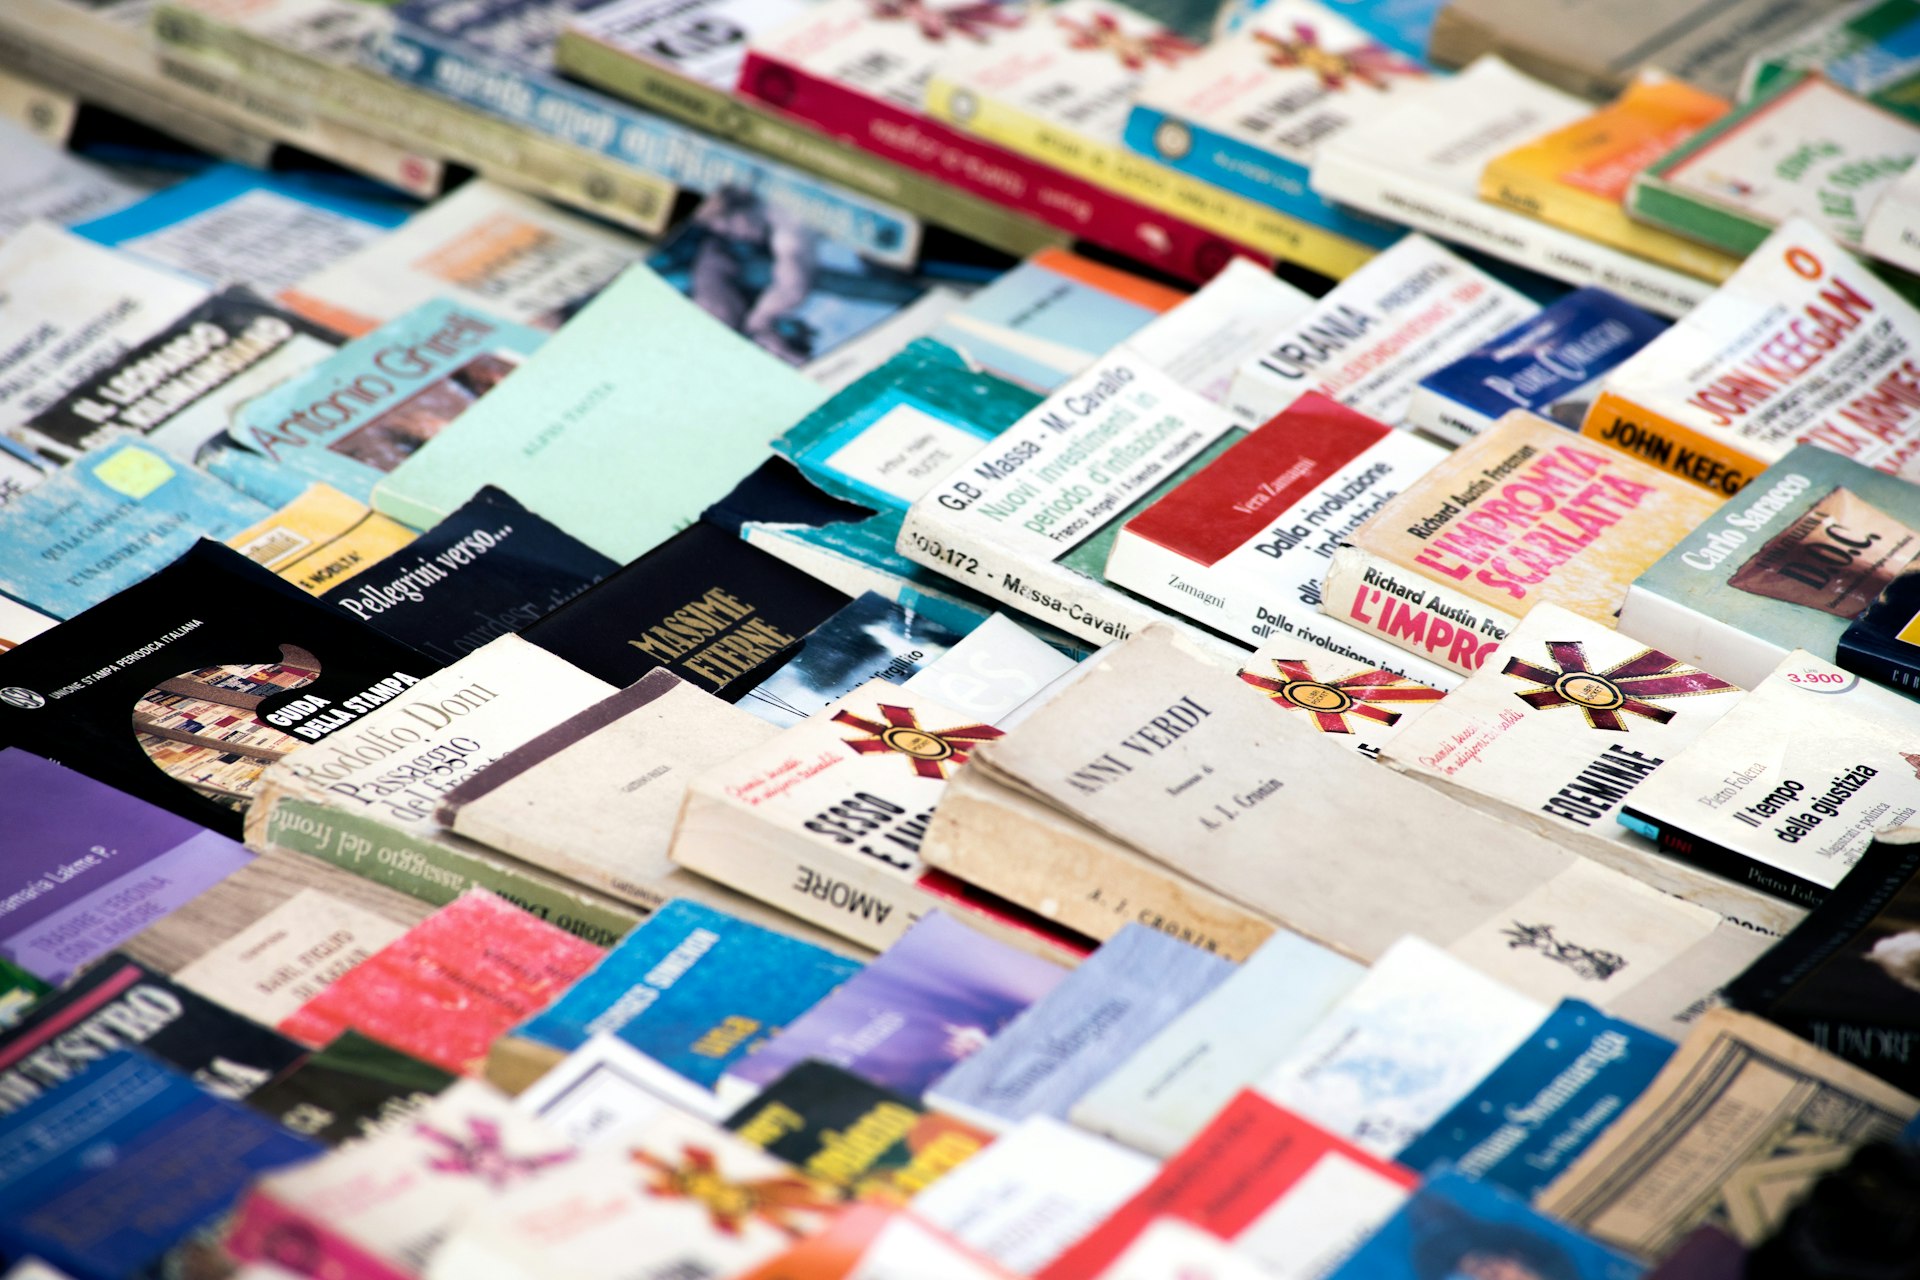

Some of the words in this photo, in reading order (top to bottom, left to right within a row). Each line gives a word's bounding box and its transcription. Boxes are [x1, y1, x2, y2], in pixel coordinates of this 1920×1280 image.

[1259, 305, 1377, 380] URANIA
[1686, 369, 1778, 427] JOHN
[1745, 277, 1875, 383] KEEGAN
[251, 372, 396, 463] Antonio
[974, 438, 1042, 483] Massa
[1064, 365, 1136, 417] Cavallo
[1602, 416, 1673, 466] JOHN
[977, 481, 1041, 523] Nuovi
[1029, 404, 1139, 490] investimenti
[1023, 483, 1093, 537] periodo
[1089, 412, 1186, 485] d'inflazione
[1407, 501, 1457, 540] Richard
[1451, 476, 1497, 516] Austin
[1482, 446, 1540, 486] Freeman
[1050, 516, 1090, 543] Franco
[1085, 493, 1121, 522] Angeli
[1233, 486, 1267, 515] Vera
[1254, 520, 1312, 559] Dalla
[1301, 460, 1394, 527] rivoluzione
[1414, 446, 1612, 582] L'IMPRONTA
[1681, 529, 1748, 572] Carlo
[1726, 472, 1812, 533] Saracco
[1476, 474, 1660, 600] SCARLATTA
[1777, 523, 1882, 591] D.O.C.
[338, 556, 448, 622] Pellegrini
[435, 524, 513, 572] verso...
[1168, 573, 1227, 609] Zamagni
[1363, 566, 1426, 606] Richard
[1426, 598, 1478, 630] Austin
[628, 586, 756, 665] MASSIME
[682, 616, 796, 687] ETERNE
[1256, 606, 1294, 633] Dalla
[48, 682, 86, 700] UNIONE
[81, 664, 121, 686] STAMPA
[115, 640, 166, 668] PERIODICA
[160, 618, 204, 644] ITALIANA
[1787, 672, 1844, 685] 3.900
[265, 694, 332, 727] GUIDA
[293, 708, 357, 740] DELLA
[342, 671, 420, 716] STAMPA
[294, 720, 421, 789] Rodolfo
[416, 676, 500, 733] Doni
[328, 734, 482, 806] Passaggio
[1065, 752, 1134, 797] ANNI
[1121, 695, 1213, 757] VERDI
[380, 772, 437, 824] del
[804, 791, 907, 845] SESSO
[1232, 777, 1285, 810] Cronin
[1541, 744, 1666, 828] FOEMINAE
[1699, 779, 1734, 810] Pietro
[1733, 806, 1762, 828] Il
[1750, 779, 1807, 820] tempo
[1774, 802, 1824, 845] della
[1814, 764, 1879, 818] giustizia
[338, 831, 373, 864] del
[859, 845, 911, 871] E
[1817, 825, 1860, 861] Magistrati
[1860, 800, 1892, 831] politica
[793, 864, 894, 926] AMORE
[1749, 866, 1787, 892] Pietro
